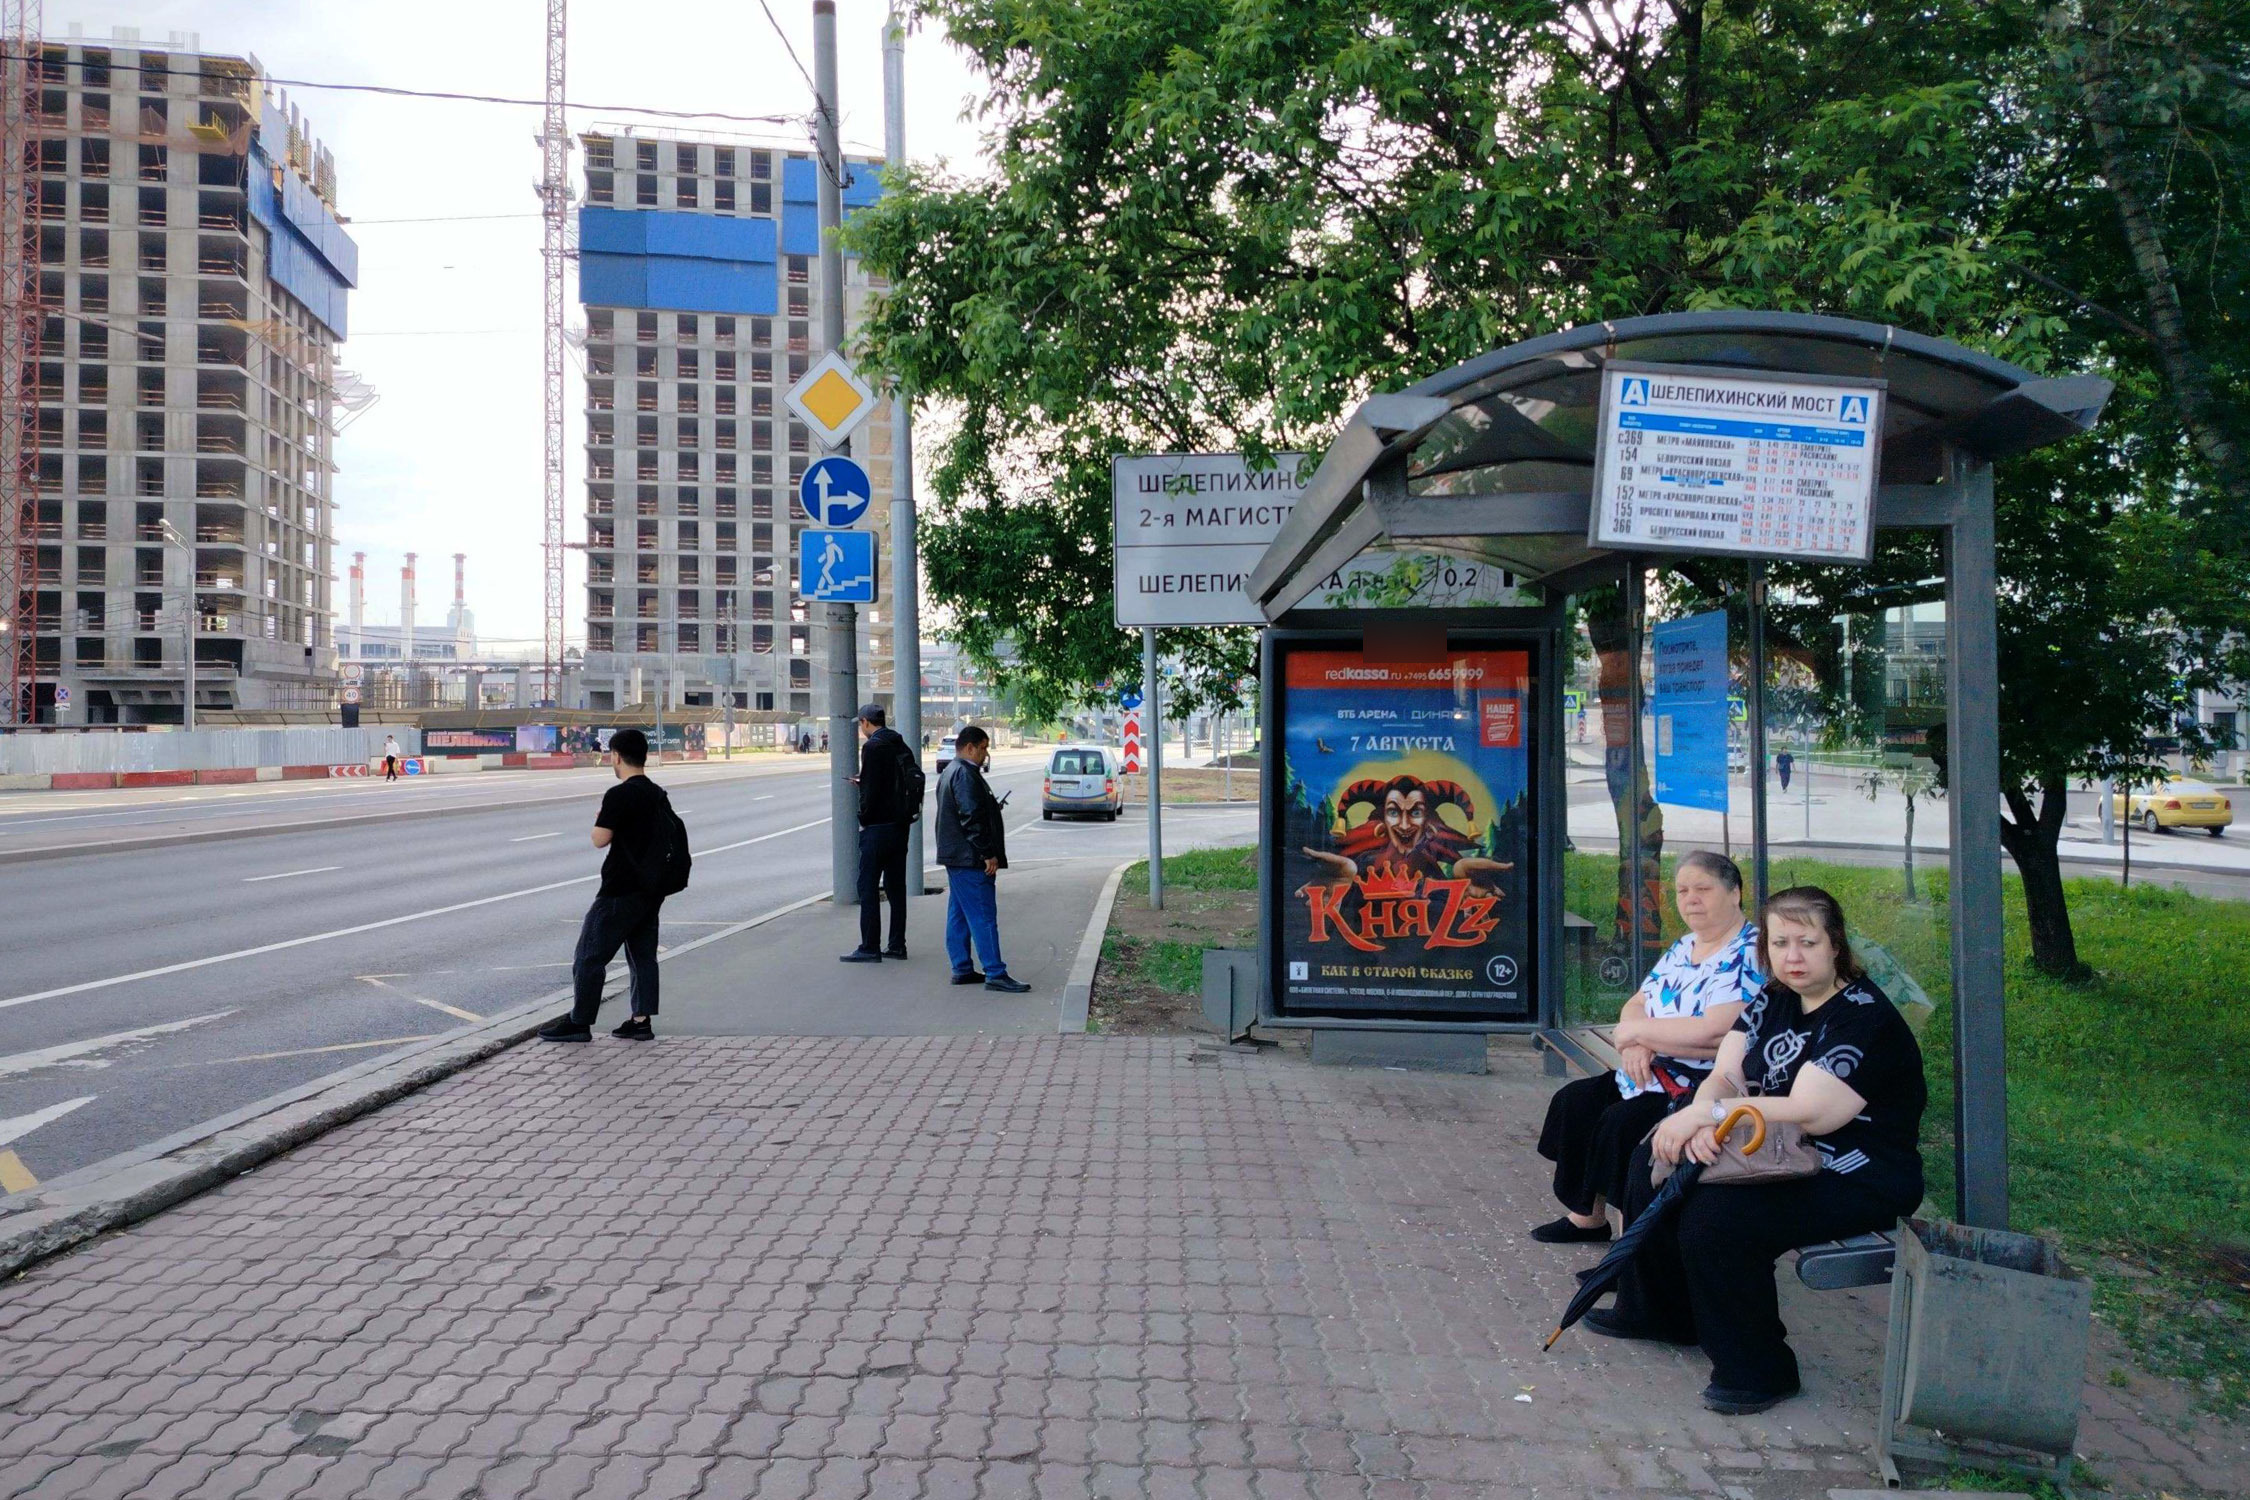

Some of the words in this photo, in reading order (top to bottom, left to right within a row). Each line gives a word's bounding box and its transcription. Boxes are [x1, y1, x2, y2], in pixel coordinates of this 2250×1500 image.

[1623, 379, 1647, 405] А
[1651, 384, 1786, 409] ШЕЛЕПИХИНСКИЙ
[1792, 395, 1836, 413] МОСТ
[1841, 397, 1866, 422] А
[1656, 435, 1680, 447] МЕТРО
[1799, 442, 1832, 453] СМОТРИТЕ
[1656, 453, 1704, 466] БЕЛОРУССКИЙ
[1705, 457, 1732, 468] ВОКЗАЛ
[1620, 466, 1634, 481] 69
[1640, 465, 1664, 476] МЕТРО
[1796, 478, 1828, 488] СМОТРИТЕ
[1616, 485, 1635, 501] 152
[1638, 489, 1662, 500] МЕТРО
[1139, 508, 1175, 527] 2-я
[1185, 506, 1294, 527] МАГИСТ
[1615, 502, 1633, 518] 155
[1639, 506, 1673, 517] ПРОСПЕКТ
[1674, 509, 1709, 521] МАРШАЛА
[1710, 512, 1739, 523] ЖУКОВА
[1612, 519, 1632, 534] 366
[1650, 525, 1696, 538] БЕЛОРУССКИЙ
[1698, 528, 1725, 539] ВОКЗАЛ
[1139, 573, 1250, 593] ШЕЛЕПИ
[1324, 667, 1402, 681] redkassa.ru
[1337, 710, 1356, 719] ВТБ
[1358, 709, 1398, 719] АРЕНА
[1486, 704, 1515, 714] НАШЕ
[1350, 736, 1360, 752] 7
[1365, 735, 1456, 756] АВГУСТА
[1321, 965, 1348, 977] КАК
[1351, 966, 1360, 977] В
[1363, 965, 1416, 978] СТАРОЙ
[1494, 964, 1512, 978] 12+
